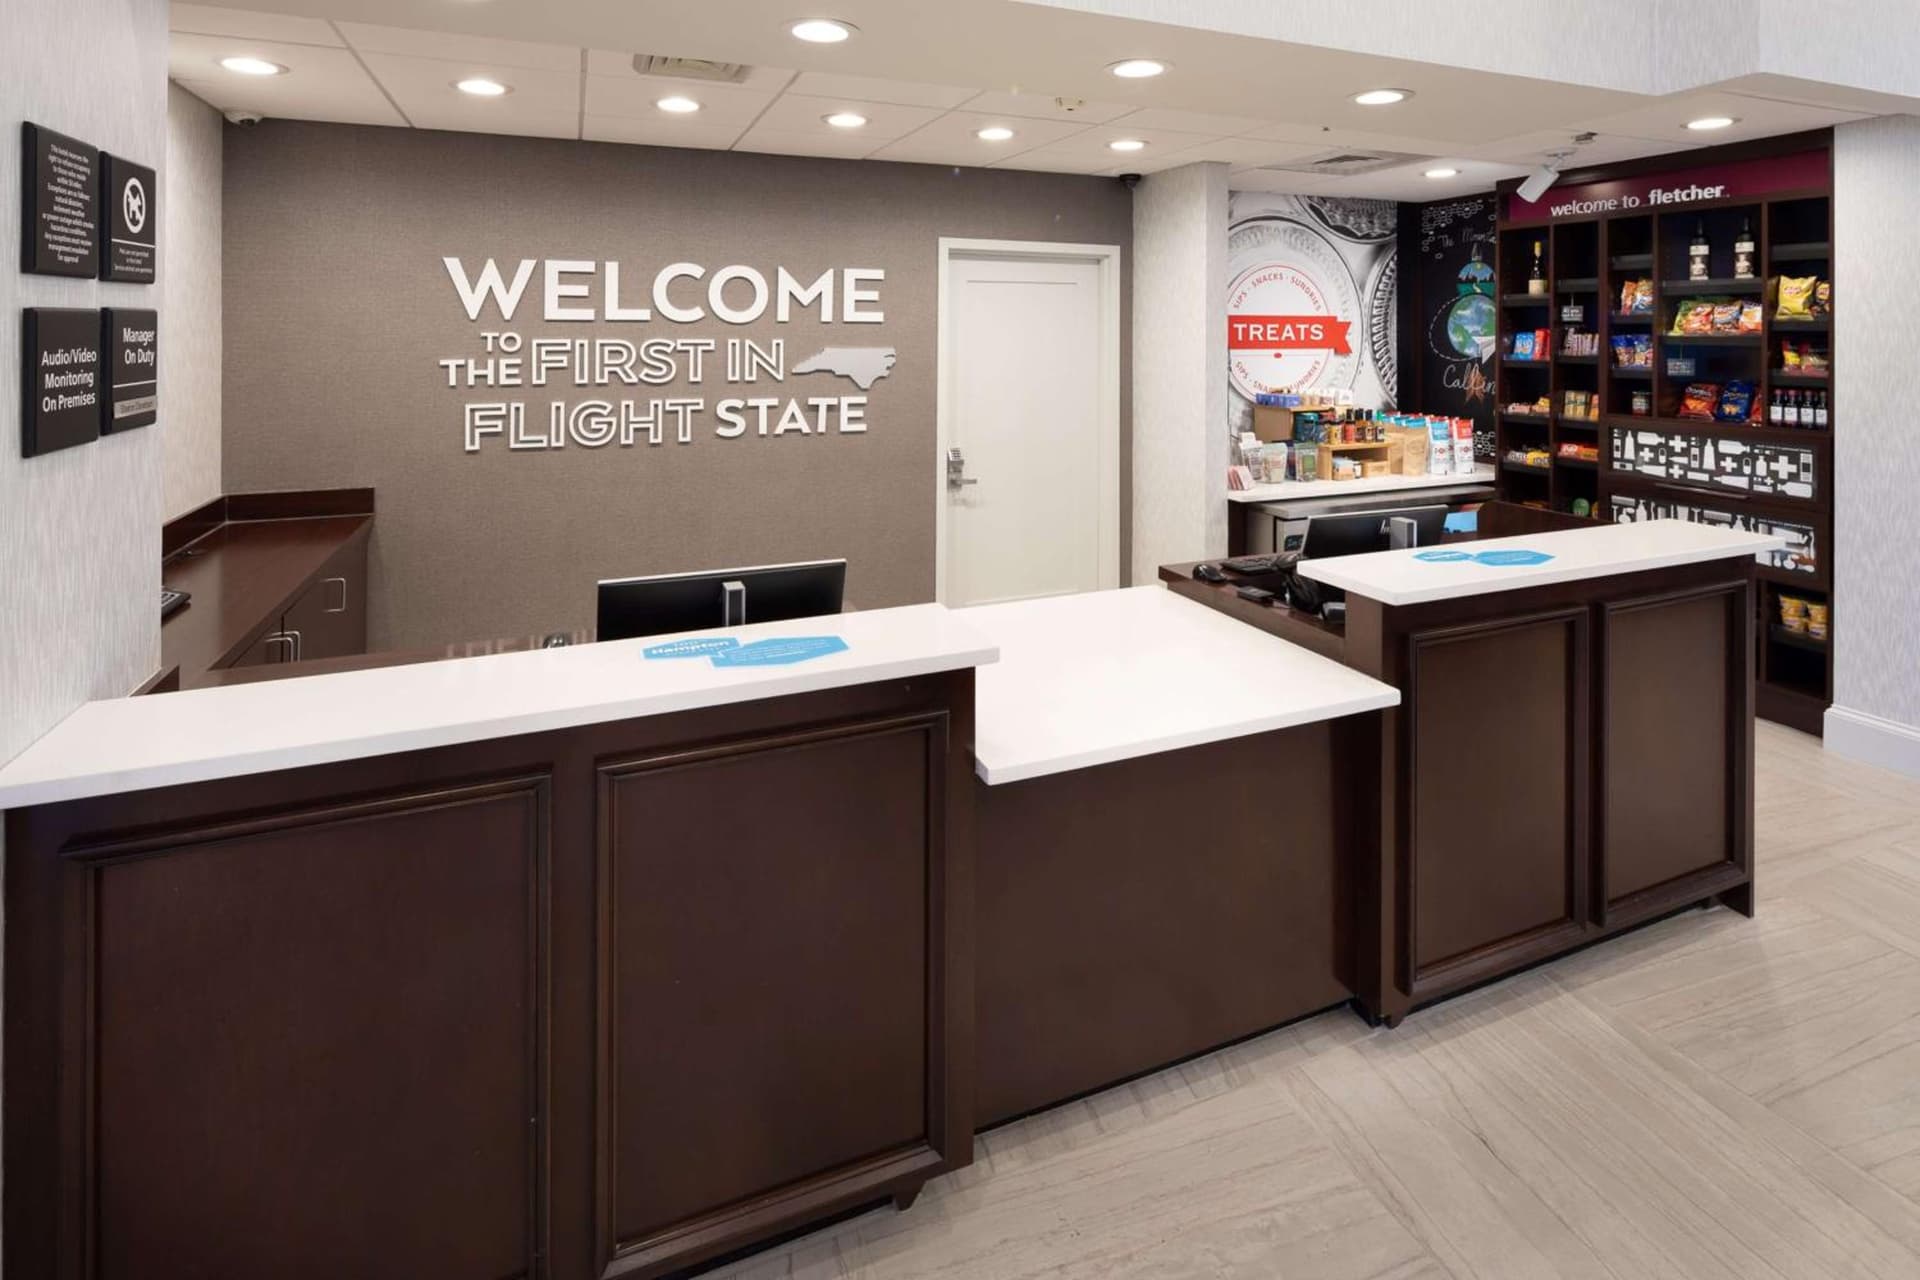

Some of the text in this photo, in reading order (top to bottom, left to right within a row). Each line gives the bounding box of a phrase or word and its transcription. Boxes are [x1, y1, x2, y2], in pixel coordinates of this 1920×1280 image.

[1551, 197, 1617, 217] welcome
[1622, 195, 1640, 208] to
[443, 257, 886, 324] WELCOME
[1251, 272, 1284, 288] SNACKS
[1290, 275, 1322, 312] SUNDRIES
[122, 327, 155, 346] Manager
[480, 332, 522, 353] TO
[1232, 323, 1324, 341] TREATS
[41, 347, 97, 366] Audio/Video
[124, 348, 155, 366] On Duty
[439, 338, 785, 387] THE FIRST IN
[44, 369, 94, 389] Monitoring
[42, 391, 96, 412] On Premises
[465, 396, 868, 452] FLIGHT STATE
